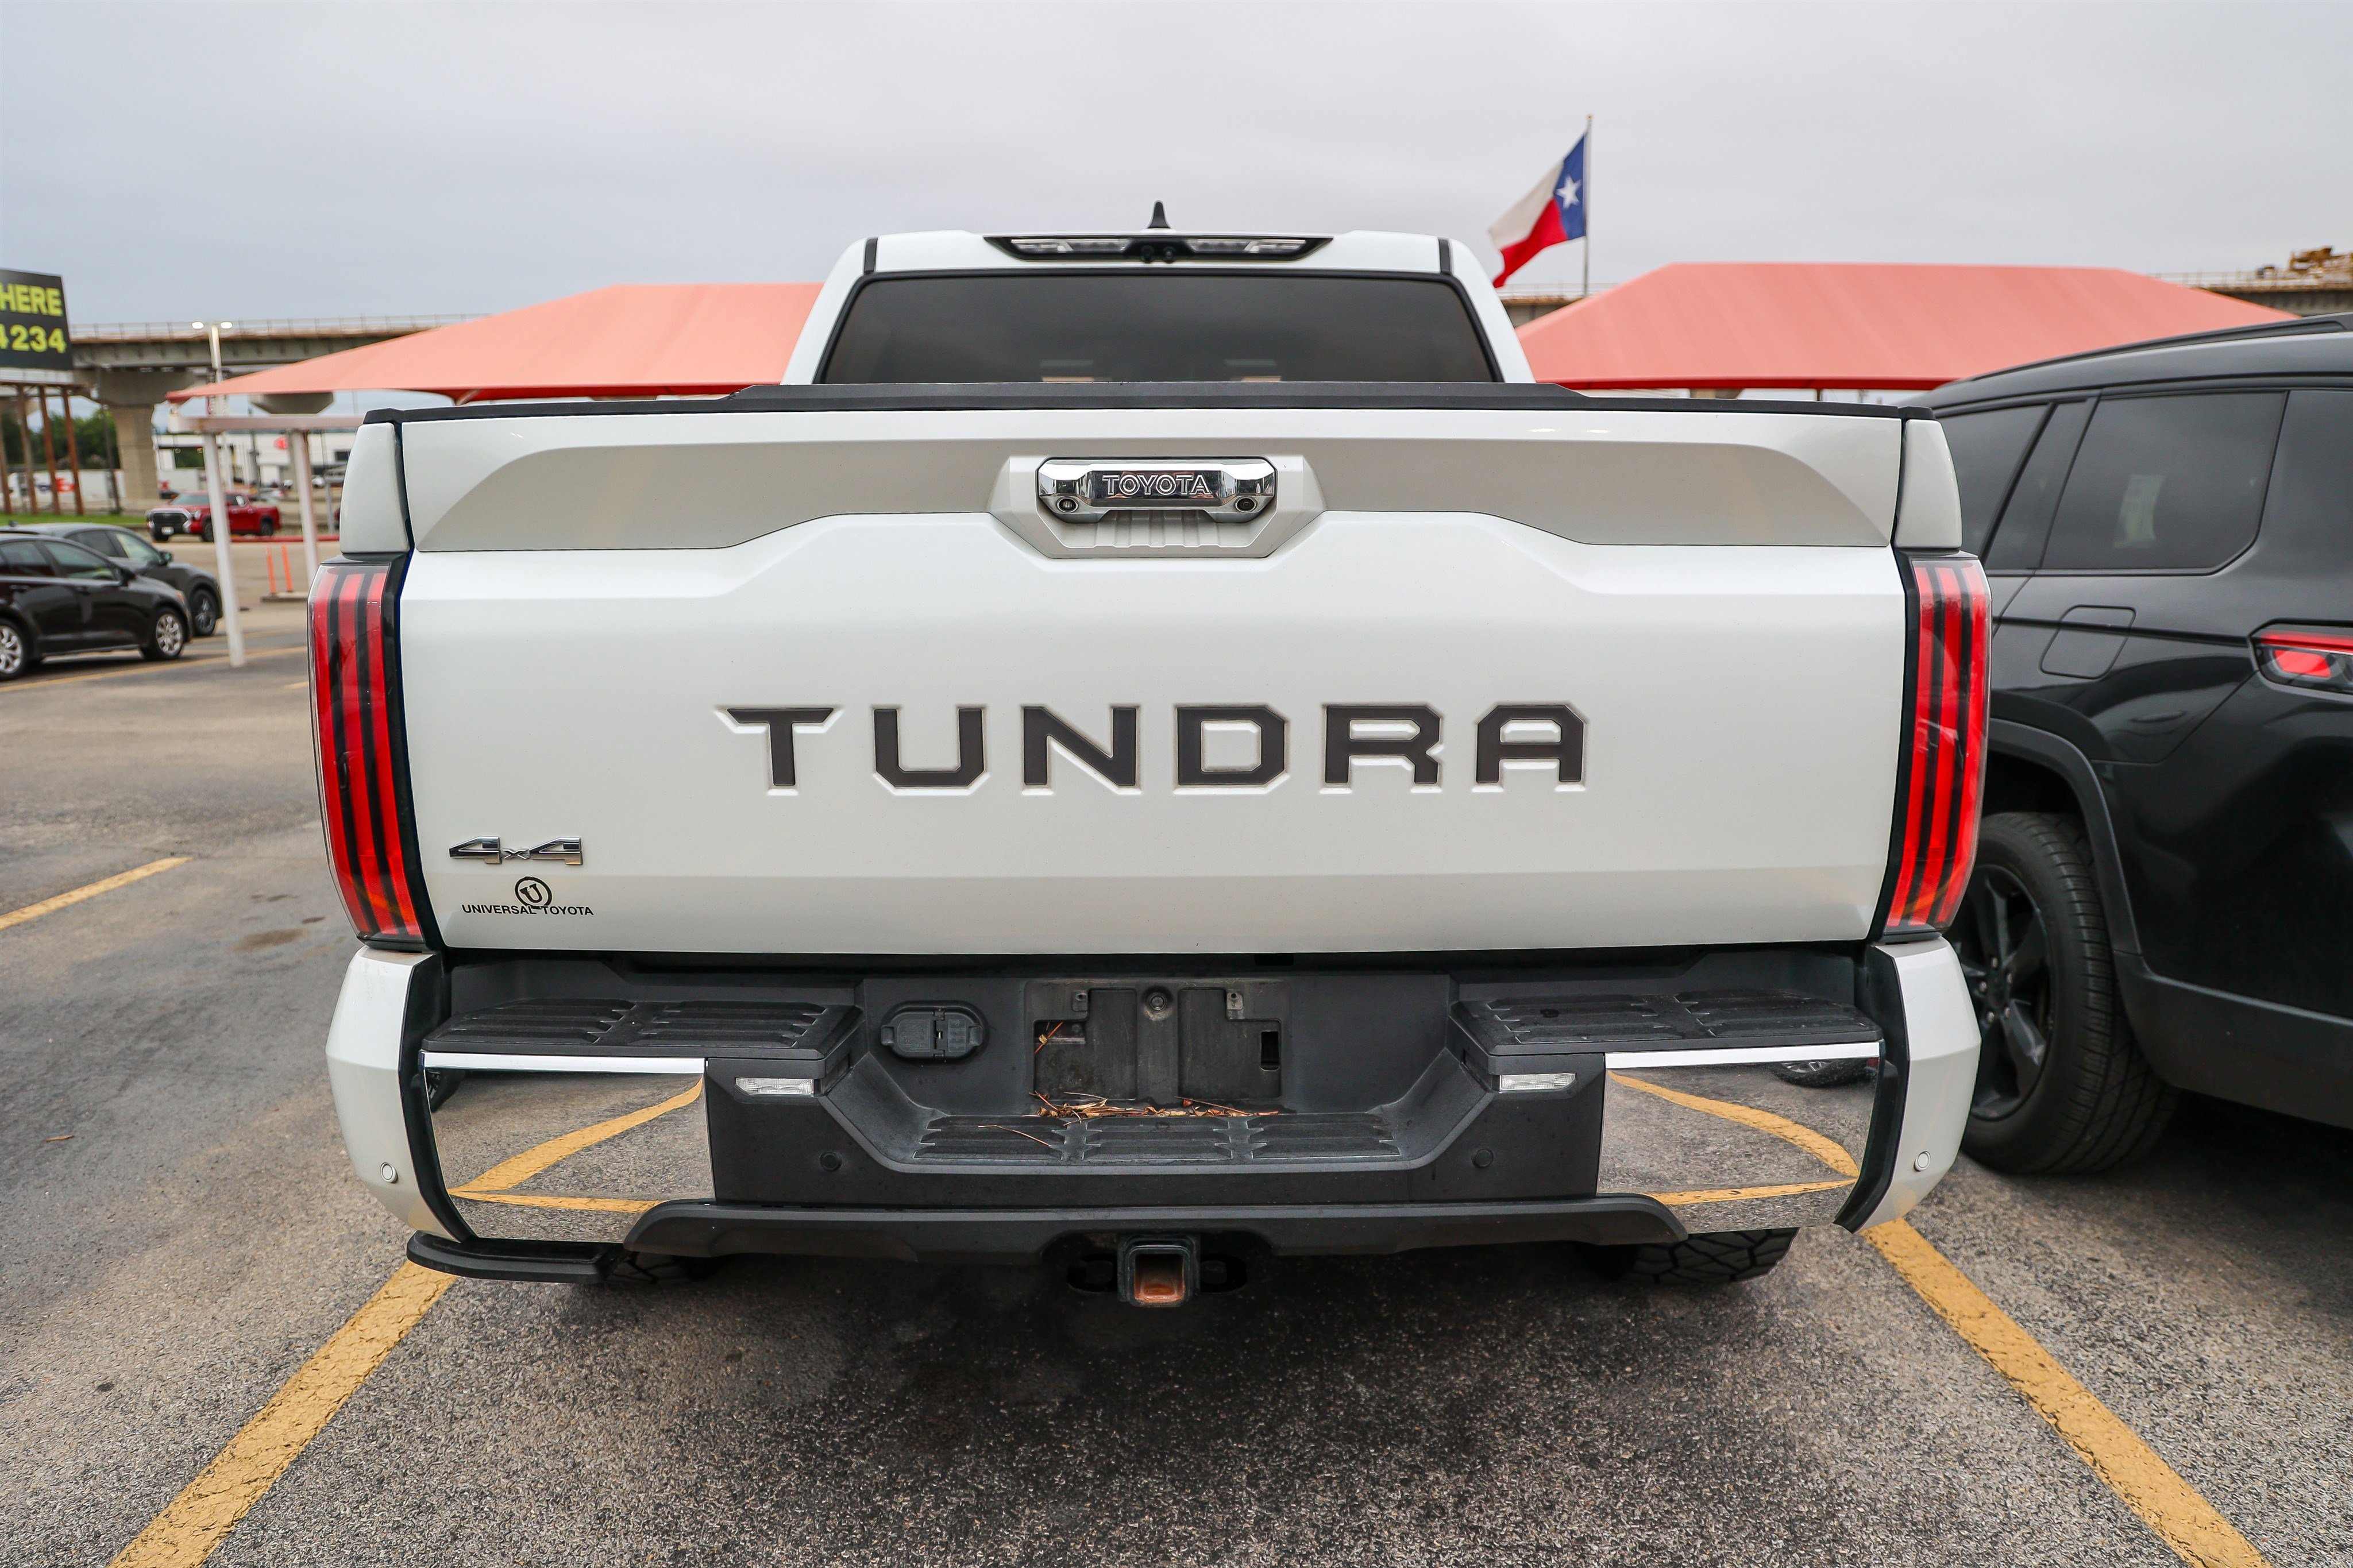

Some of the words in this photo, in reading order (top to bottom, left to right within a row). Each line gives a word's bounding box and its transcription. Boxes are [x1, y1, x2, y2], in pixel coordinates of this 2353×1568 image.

[0, 283, 63, 316] HERE
[1102, 474, 1213, 496] TOYOTA
[725, 704, 1584, 789] TUNDRA
[461, 904, 537, 916] UNIVERSAL
[542, 905, 594, 916] TOYOTA
